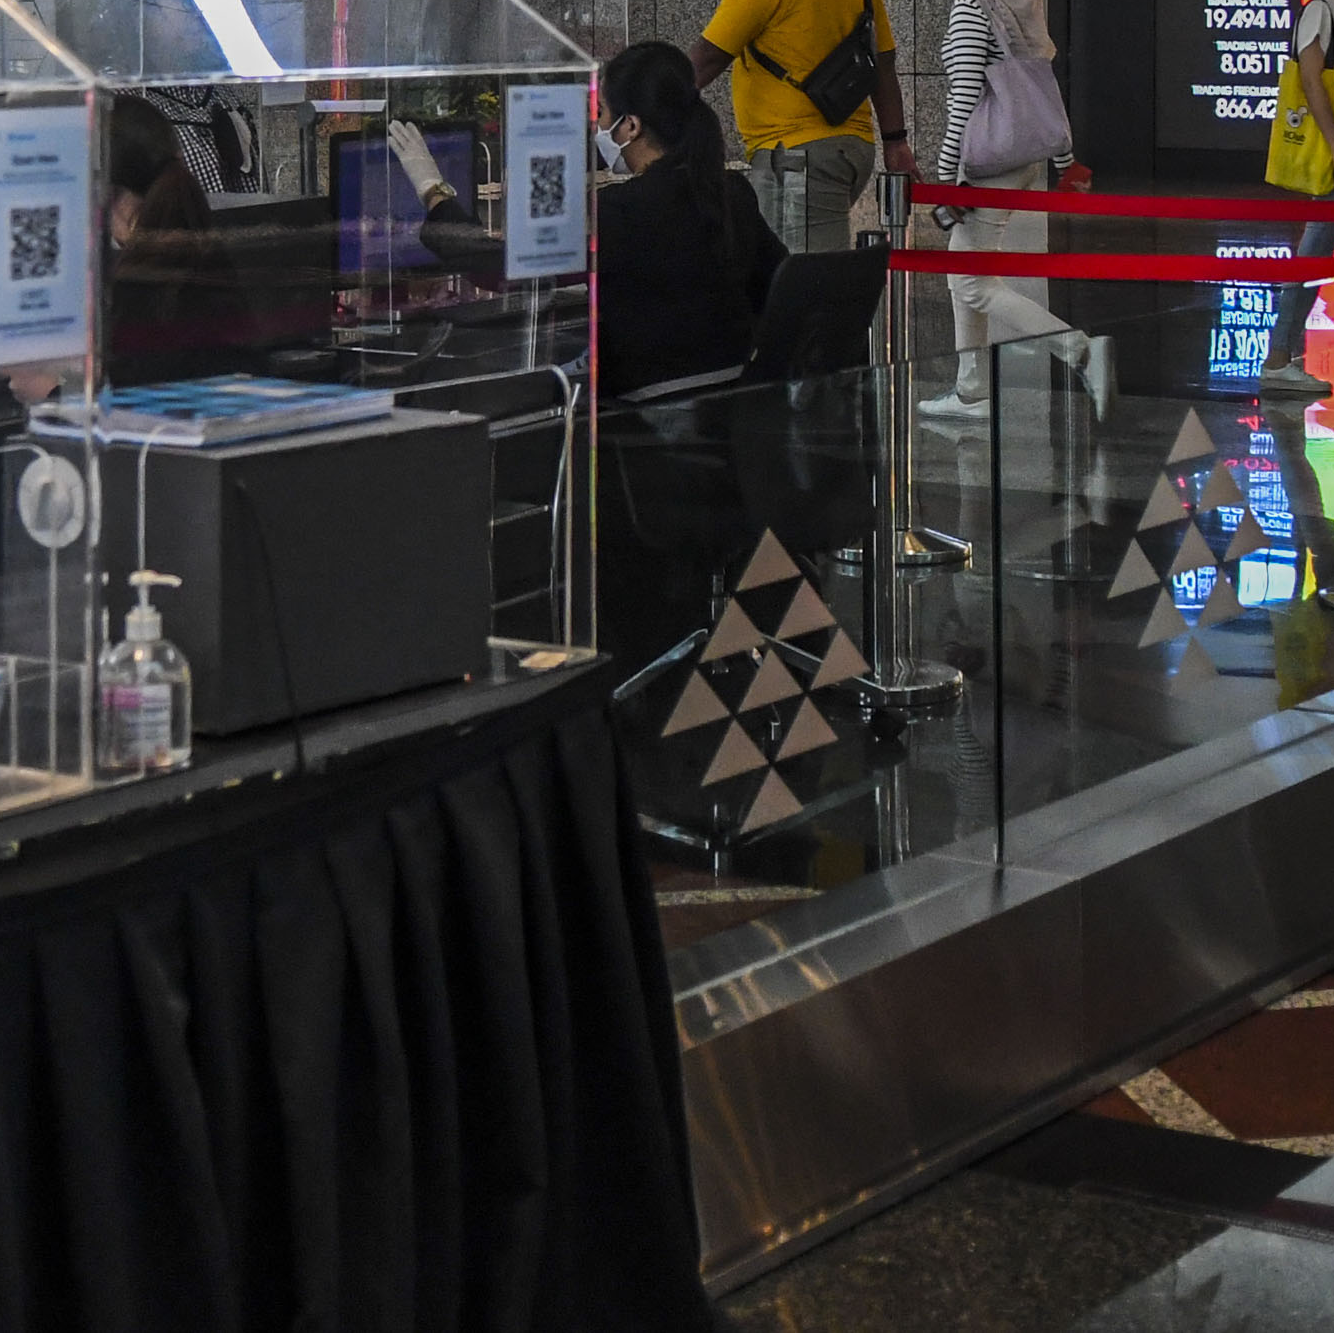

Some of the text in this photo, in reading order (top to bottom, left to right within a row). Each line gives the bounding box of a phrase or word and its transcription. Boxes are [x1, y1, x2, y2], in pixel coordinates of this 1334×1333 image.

[1203, 8, 1292, 30] 19,494 M
[1216, 41, 1289, 52] TRADING VALUE
[1220, 54, 1271, 75] 8,051
[1191, 85, 1279, 96] TRADING FREQUENC
[1215, 98, 1277, 120] 866,42
